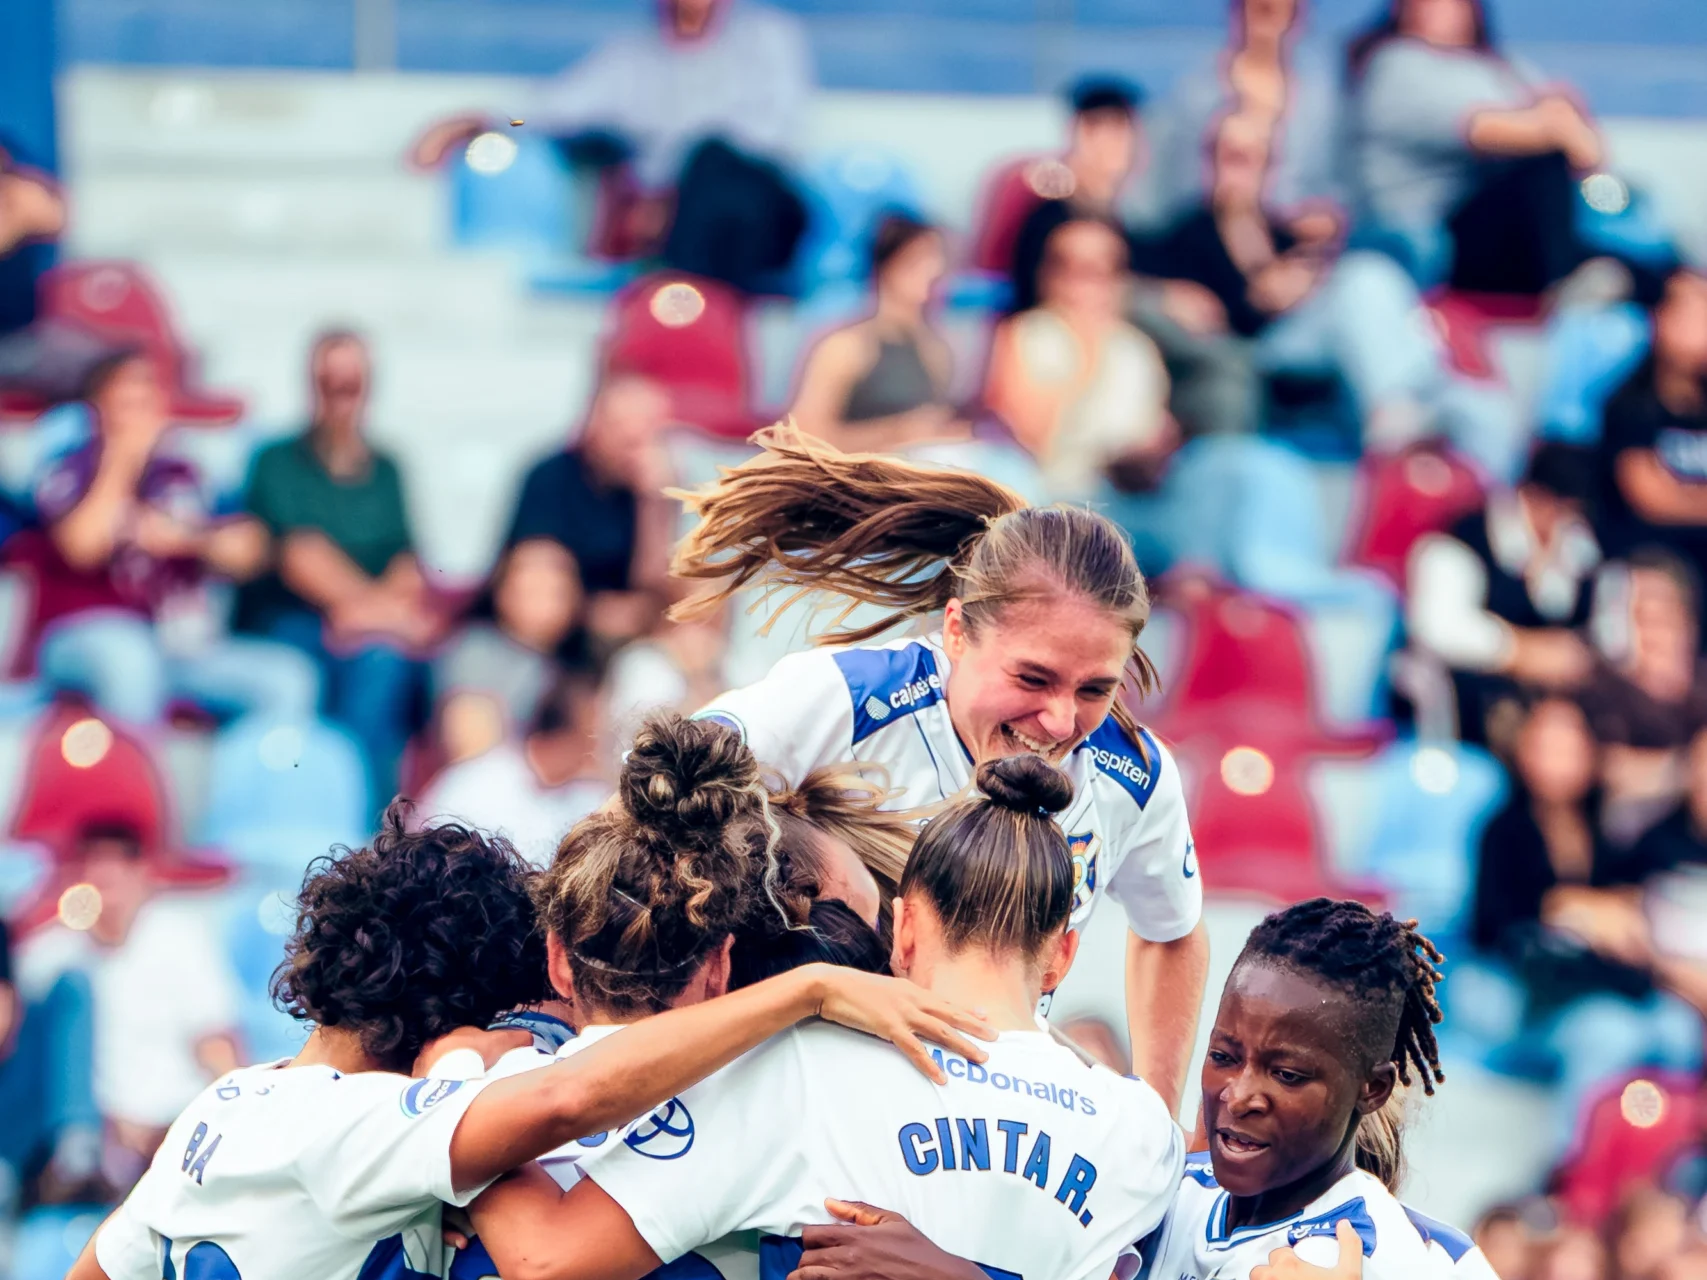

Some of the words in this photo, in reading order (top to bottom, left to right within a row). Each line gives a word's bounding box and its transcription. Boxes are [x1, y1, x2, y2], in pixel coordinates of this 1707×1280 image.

[1086, 736, 1151, 790] ospiten
[898, 1117, 1051, 1190] CINTA
[1054, 1153, 1098, 1228] R.
